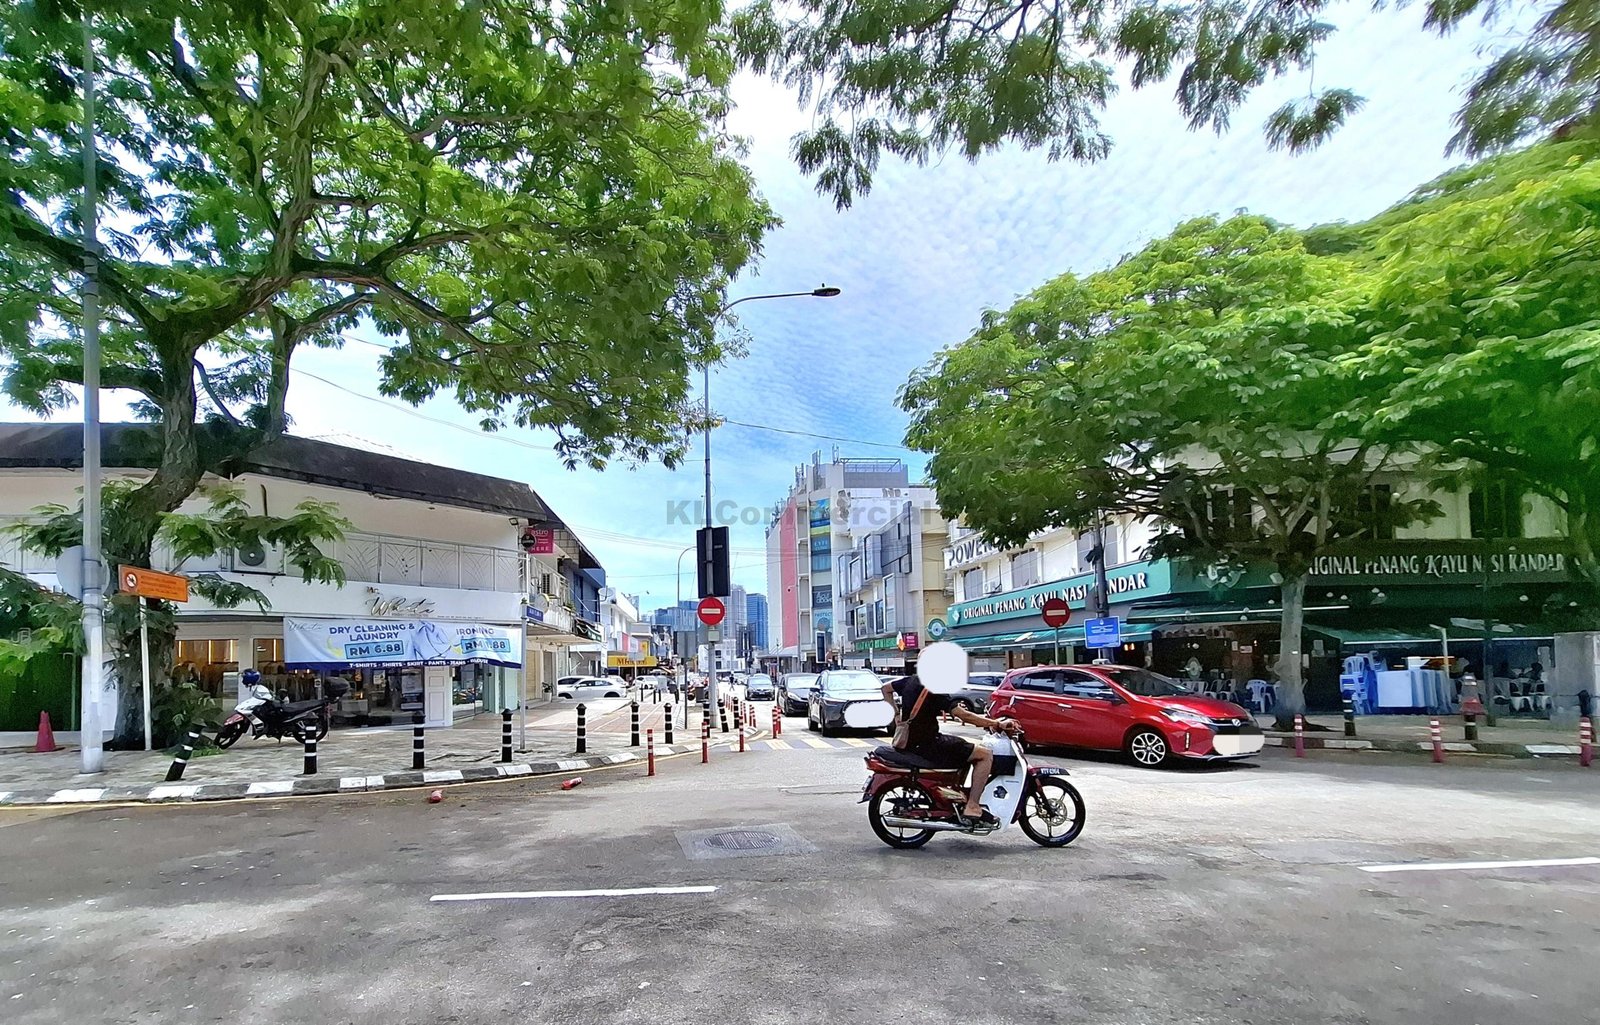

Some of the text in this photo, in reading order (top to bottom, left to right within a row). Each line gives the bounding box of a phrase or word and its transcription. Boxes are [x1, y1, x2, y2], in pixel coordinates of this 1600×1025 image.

[1424, 554, 1468, 578] KAYU
[1472, 554, 1505, 573] NSI
[963, 603, 993, 619] ORIGINAL
[995, 596, 1026, 612] PENANG
[1062, 584, 1087, 601] NASI
[329, 626, 351, 634] DRY
[354, 623, 406, 633] CLEANING
[455, 627, 495, 636] IRONING
[349, 632, 399, 642] LAUNDRY
[349, 643, 401, 656] RM 6.88
[465, 640, 482, 650] RM
